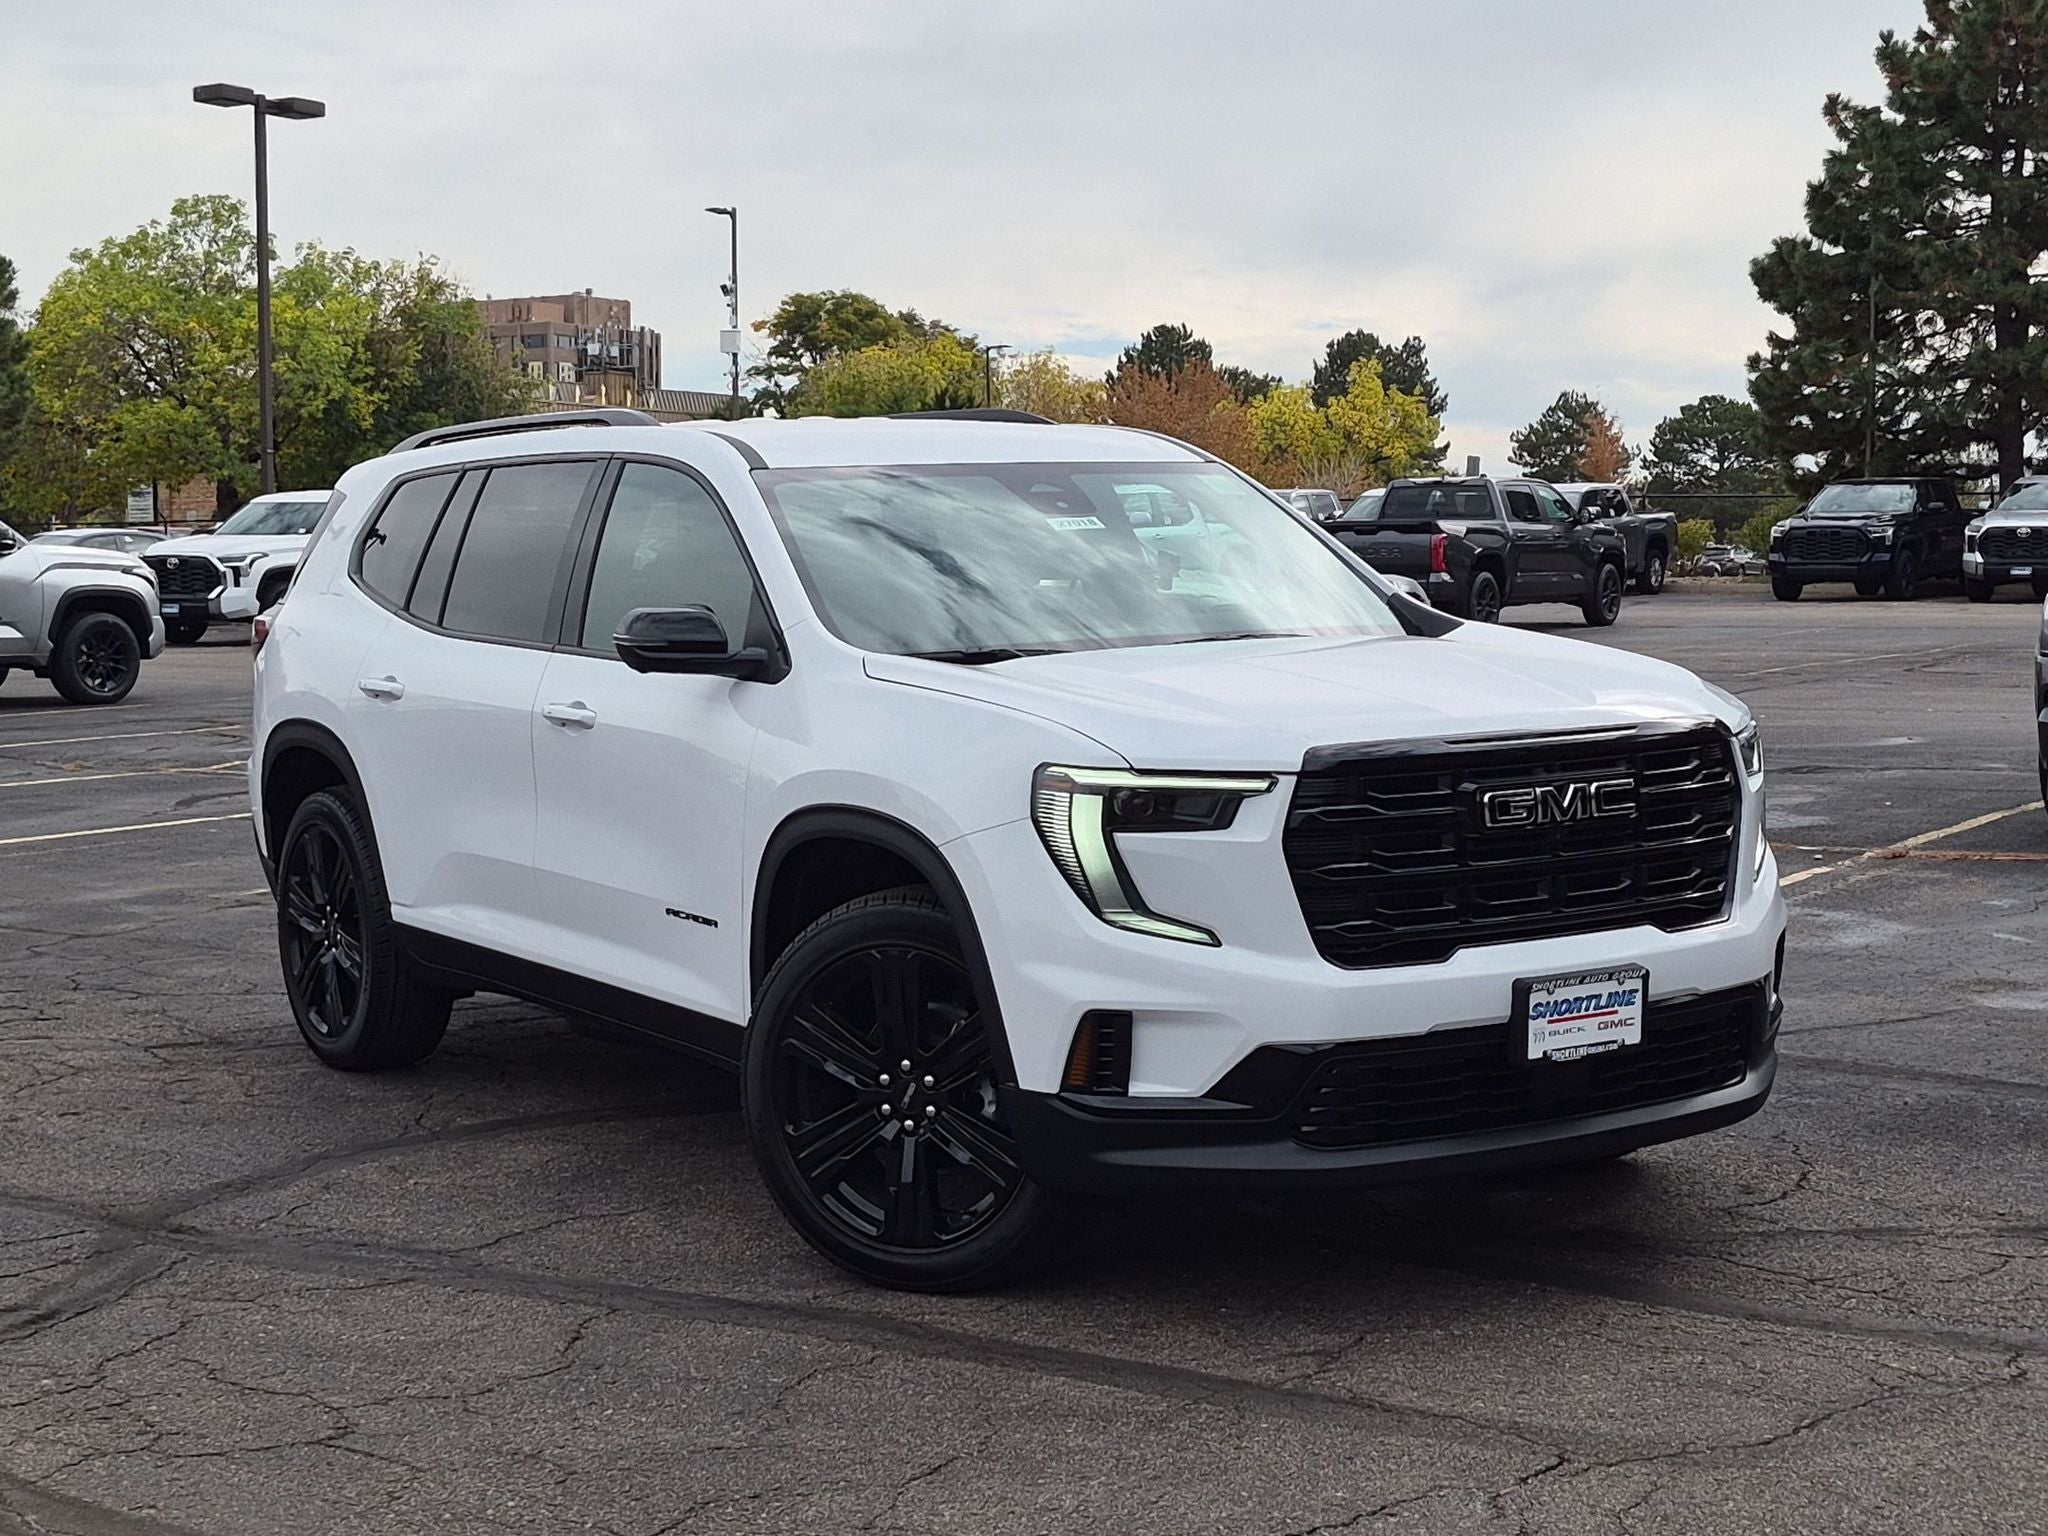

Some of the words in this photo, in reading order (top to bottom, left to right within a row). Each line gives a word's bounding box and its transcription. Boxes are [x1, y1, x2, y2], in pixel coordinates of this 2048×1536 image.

[1483, 778, 1636, 827] GMC
[1530, 977, 1581, 992] SHORTLINE
[1584, 972, 1609, 986] AUTO
[1612, 968, 1646, 980] GROUP
[1529, 989, 1640, 1021] SHORTLINE
[1548, 1026, 1586, 1037] BUICK
[1597, 1017, 1636, 1031] GMC
